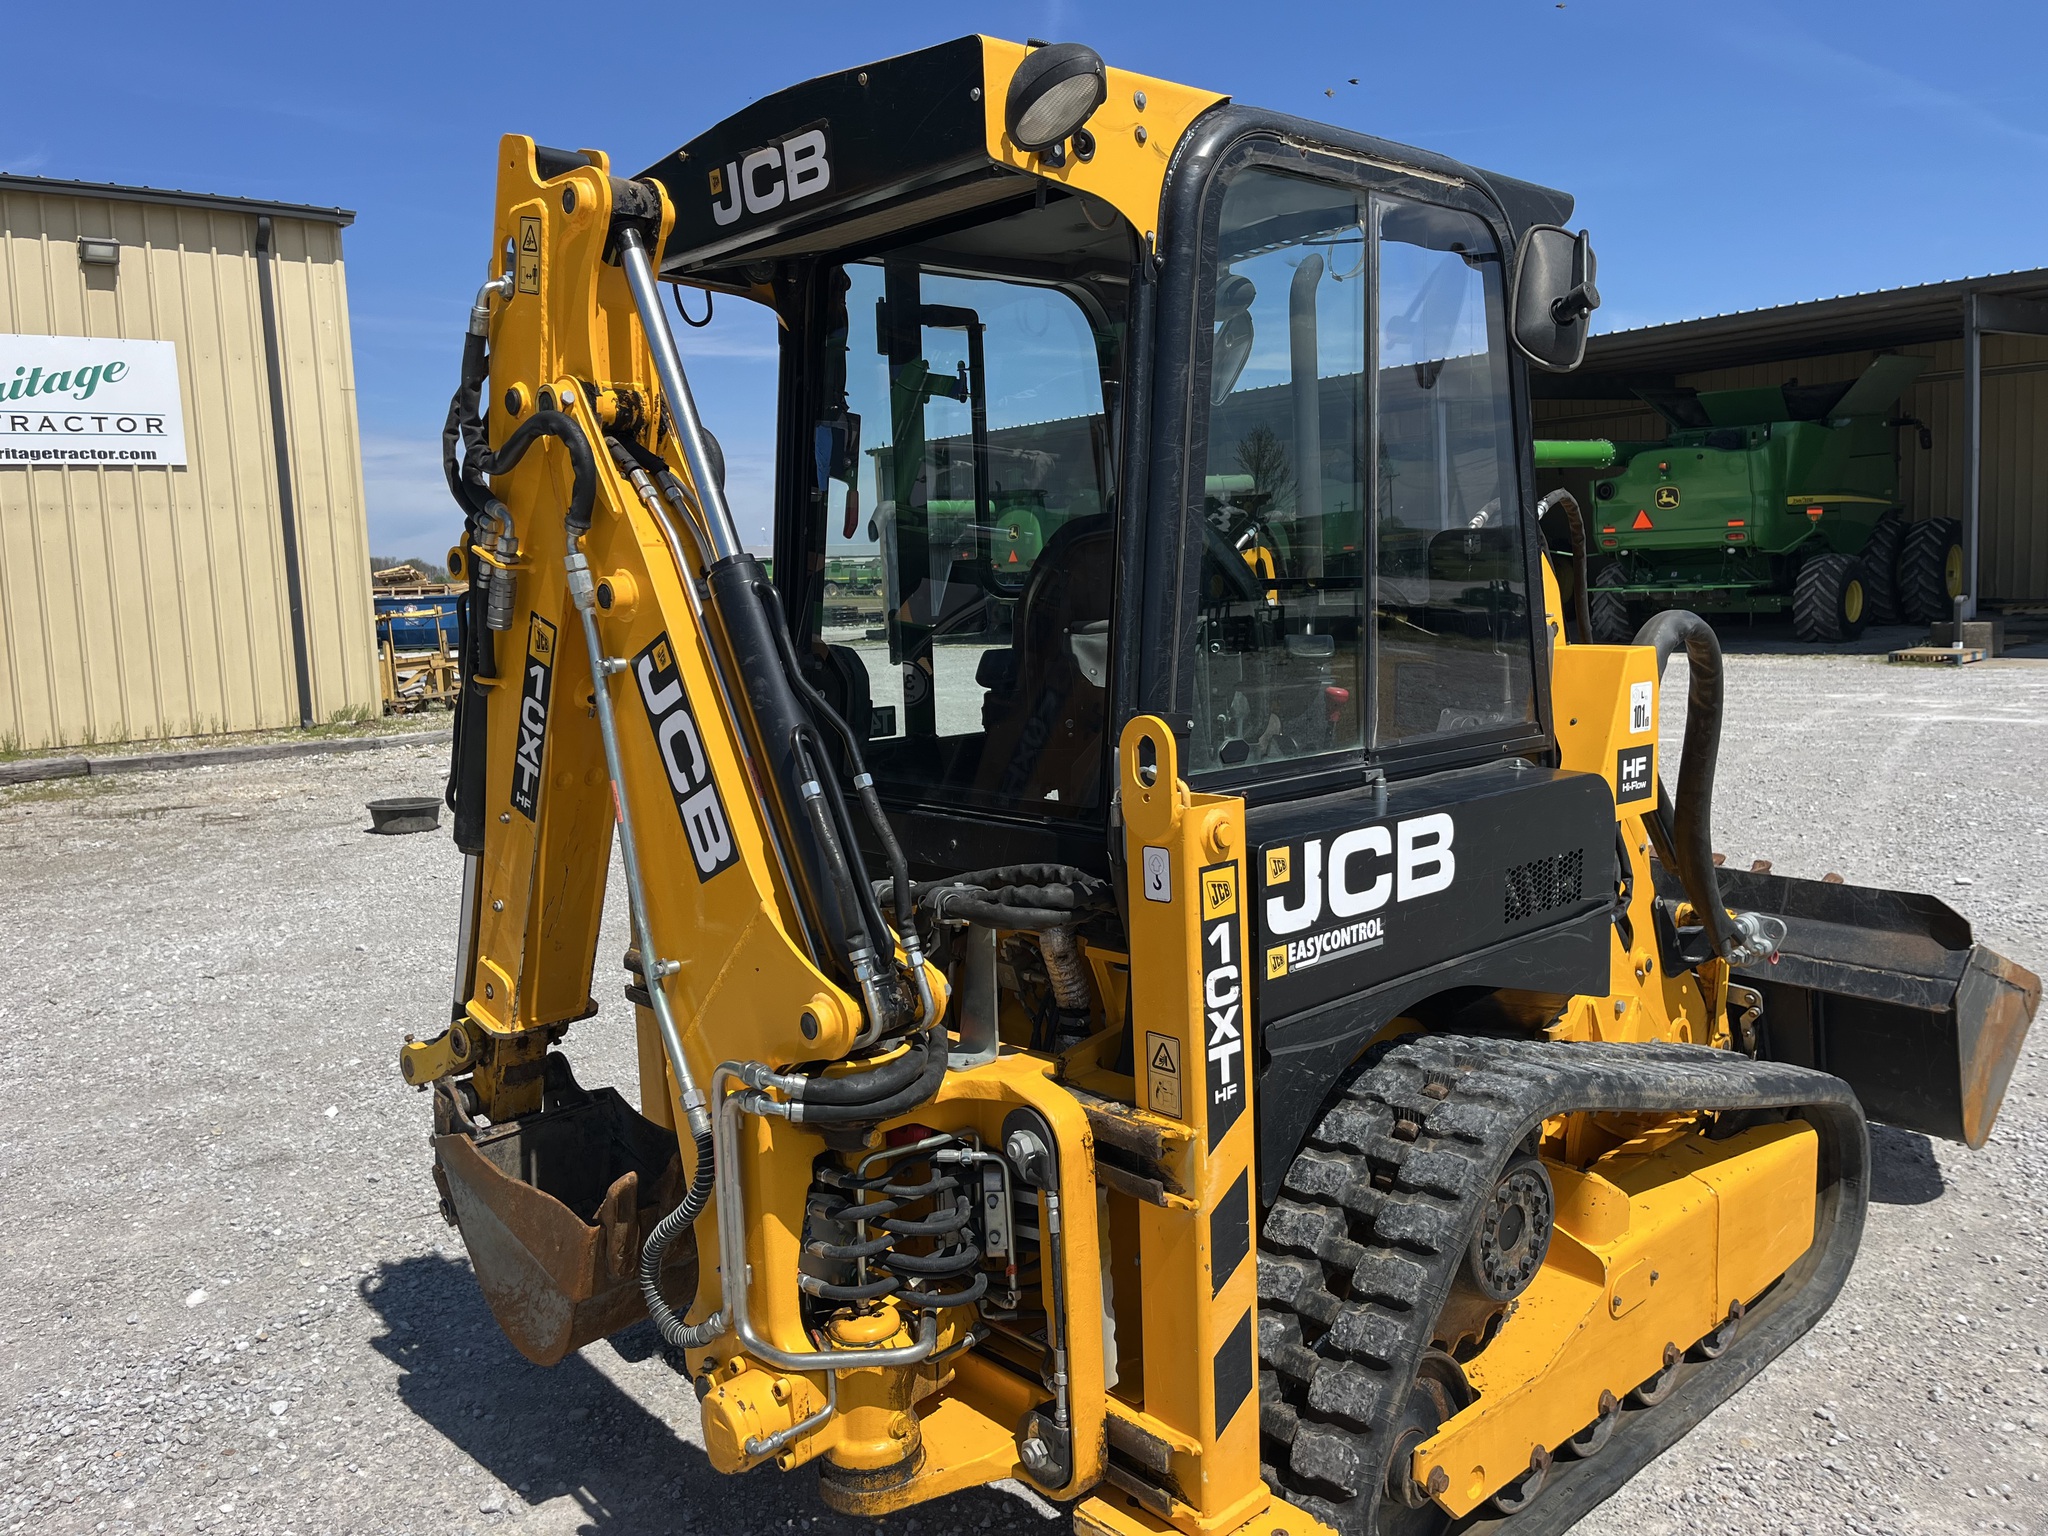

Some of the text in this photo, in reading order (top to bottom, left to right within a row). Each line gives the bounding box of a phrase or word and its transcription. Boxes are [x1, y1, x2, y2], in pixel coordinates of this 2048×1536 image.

[712, 129, 830, 226] JCB
[0, 415, 164, 433] RACTOR
[1634, 704, 1646, 728] 101
[517, 664, 545, 793] 1CXT
[637, 653, 731, 873] JCB
[1622, 756, 1647, 780] HF
[1622, 780, 1647, 793] Hi-Flow
[516, 791, 532, 808] HF
[1266, 812, 1456, 936] JCB
[1272, 858, 1287, 877] JCB
[1211, 883, 1230, 906] JCB
[1288, 917, 1384, 967] EASYCONTROL
[1271, 955, 1285, 971] JCB
[1206, 921, 1242, 1084] 1CXT
[1214, 1083, 1237, 1105] HF
